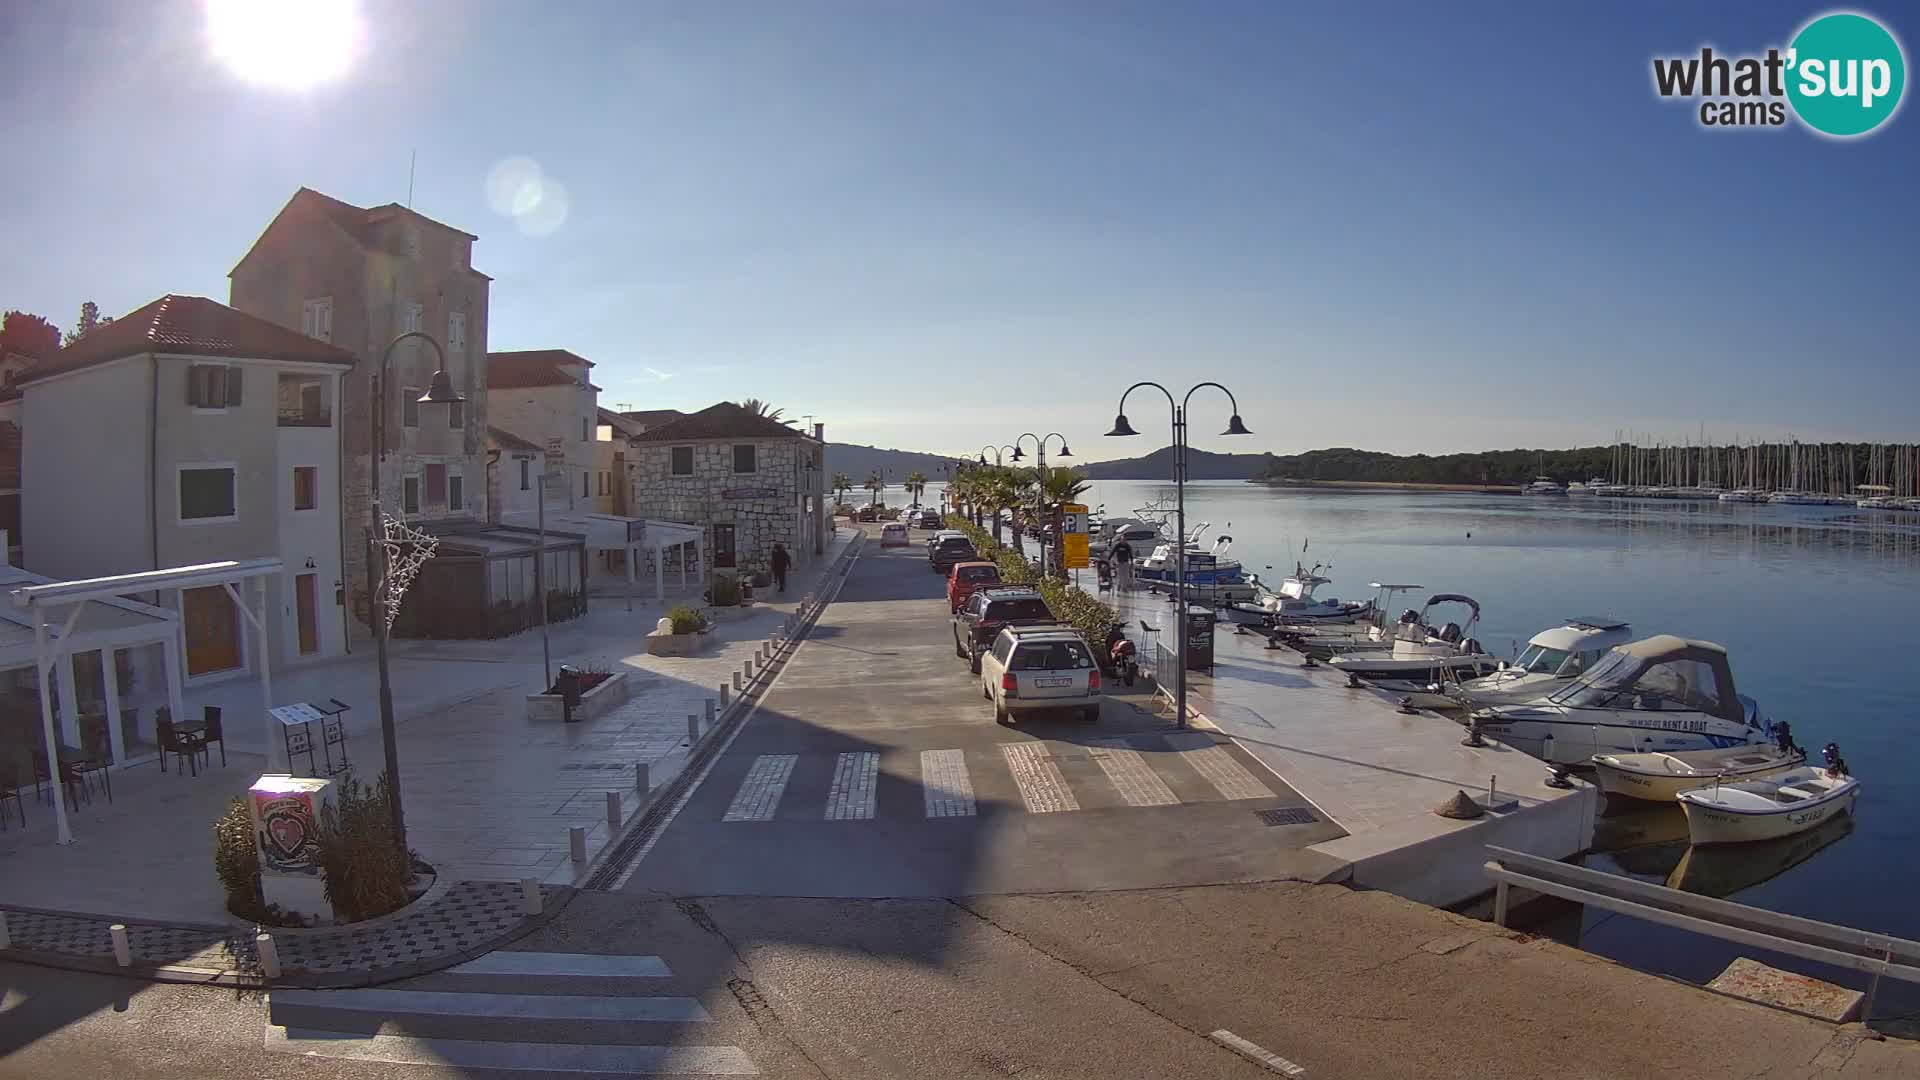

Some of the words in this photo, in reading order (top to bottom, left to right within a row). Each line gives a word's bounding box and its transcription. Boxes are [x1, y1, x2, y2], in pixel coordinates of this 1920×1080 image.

[1065, 515, 1076, 531] P
[1662, 719, 1681, 730] RENT
[1689, 721, 1708, 733] BOAT
